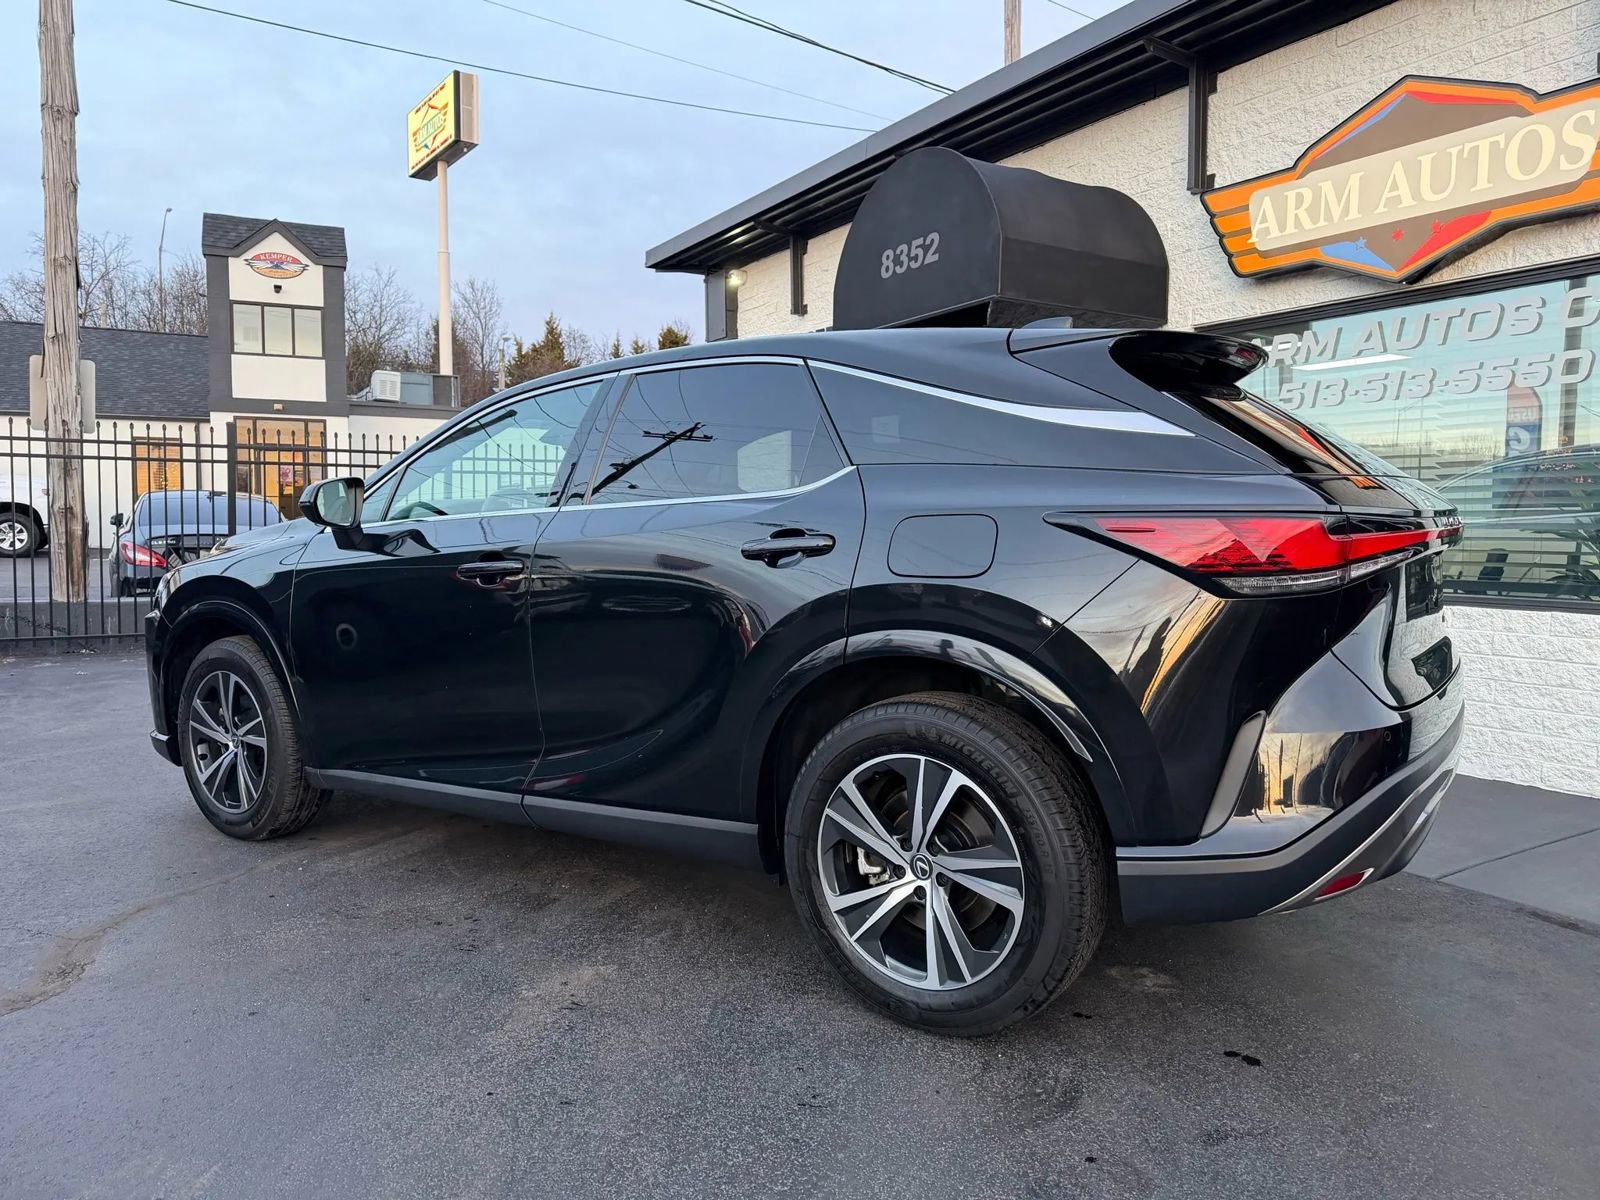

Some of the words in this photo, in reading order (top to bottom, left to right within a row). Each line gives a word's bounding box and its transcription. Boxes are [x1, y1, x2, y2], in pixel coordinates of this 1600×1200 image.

[1248, 171, 1365, 243] ARM
[1373, 109, 1599, 214] AUTOS
[880, 231, 940, 279] 8352
[1352, 295, 1546, 357] AUTOS
[1279, 350, 1595, 410] 513-513-5550
[940, 734, 1019, 798] MICHELIN
